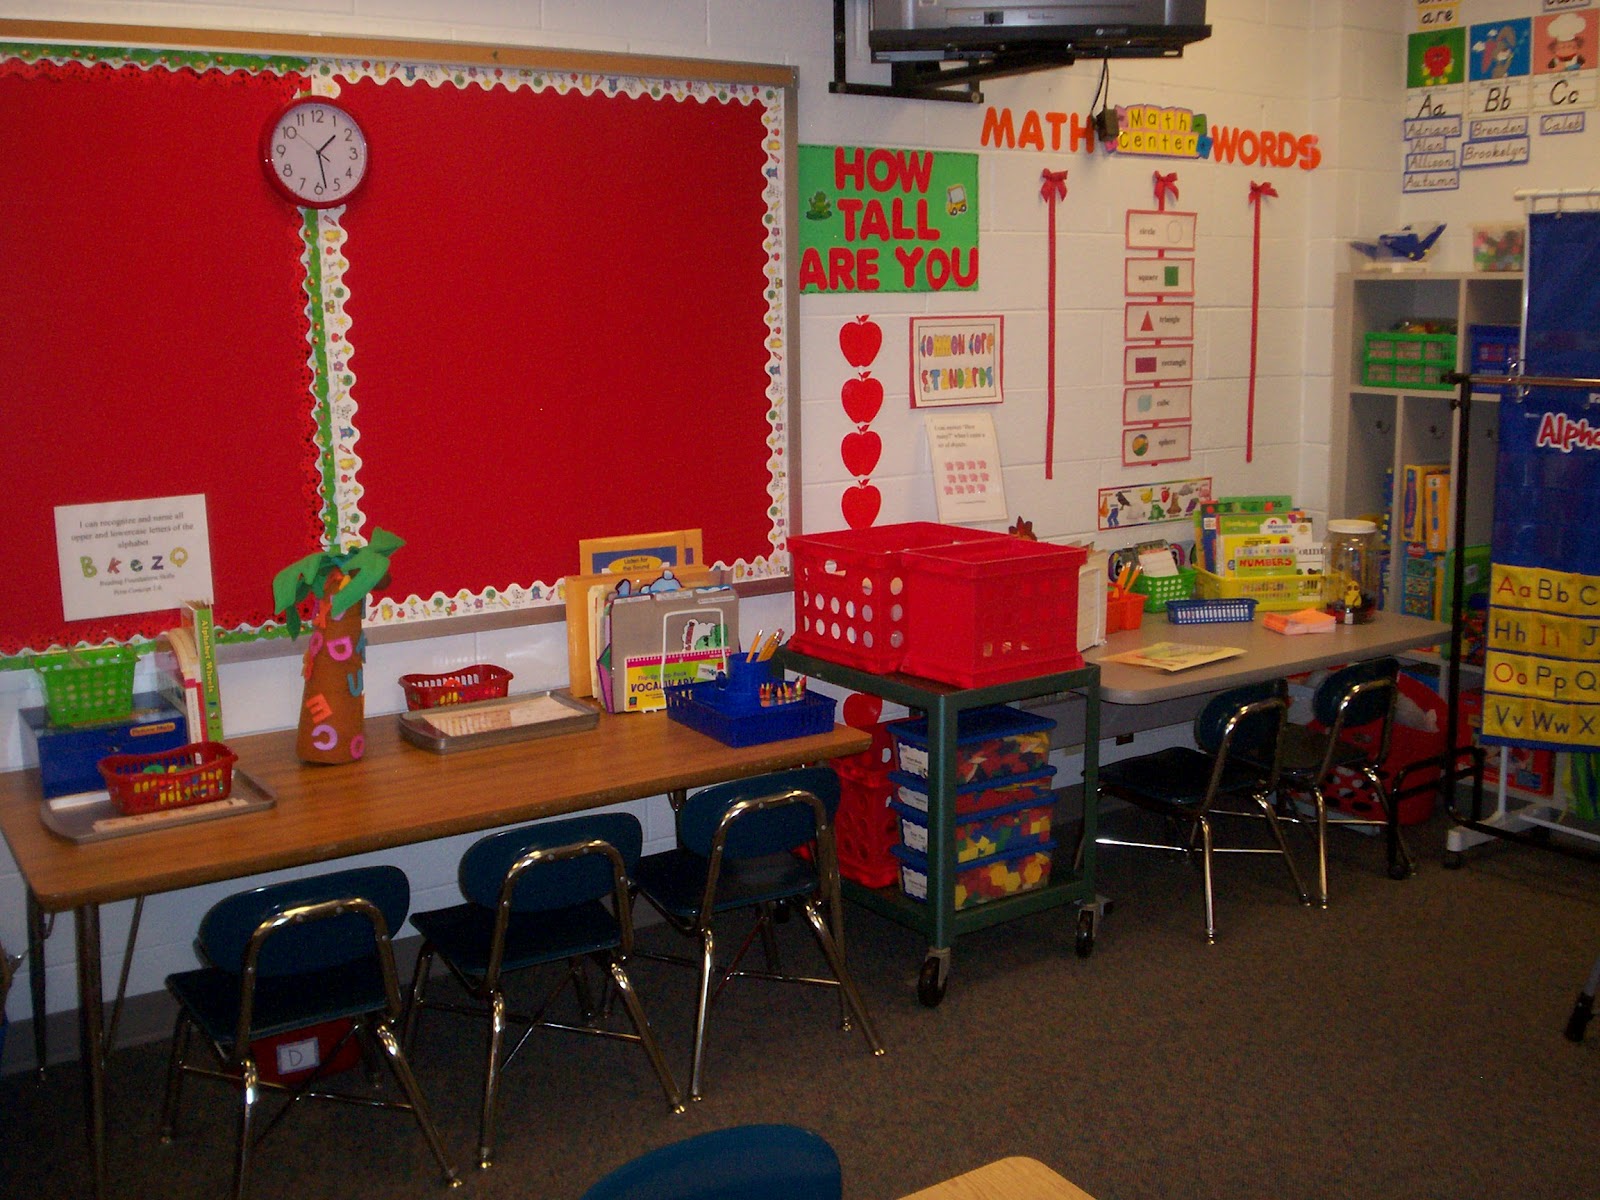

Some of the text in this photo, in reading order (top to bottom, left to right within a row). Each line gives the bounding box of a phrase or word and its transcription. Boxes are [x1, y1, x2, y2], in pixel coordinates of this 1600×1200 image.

[1420, 10, 1453, 25] are
[1416, 79, 1580, 119] Aa Bb Cc
[296, 113, 305, 126] 11
[311, 109, 324, 123] 12
[332, 115, 337, 127] 1
[1130, 110, 1190, 131] Math
[282, 126, 297, 139] 10
[344, 128, 353, 142] 2
[980, 106, 1096, 153] MATH
[1117, 131, 1198, 151] Center
[1211, 124, 1323, 171] WORDS
[276, 144, 286, 158] 9
[349, 147, 358, 160] 3
[282, 163, 293, 177] 8
[345, 167, 352, 179] 4
[834, 146, 934, 194] HOW
[300, 178, 306, 191] 7
[314, 182, 323, 195] 6
[333, 178, 341, 191] 5
[837, 197, 940, 242] TALL
[799, 246, 979, 291] ARE YOU
[138, 515, 151, 523] and
[94, 531, 109, 539] and
[79, 555, 97, 578] B
[130, 559, 143, 572] e
[1239, 557, 1293, 568] NUMBERS
[1497, 576, 1531, 598] Aa
[1538, 578, 1570, 603] Bb
[1494, 619, 1526, 643] Hh
[1540, 624, 1561, 648] Ii
[1493, 662, 1528, 686] Oo
[1536, 666, 1567, 697] Pp
[1495, 704, 1524, 728] Vv
[1532, 710, 1570, 734] Ww
[288, 1049, 303, 1067] D
